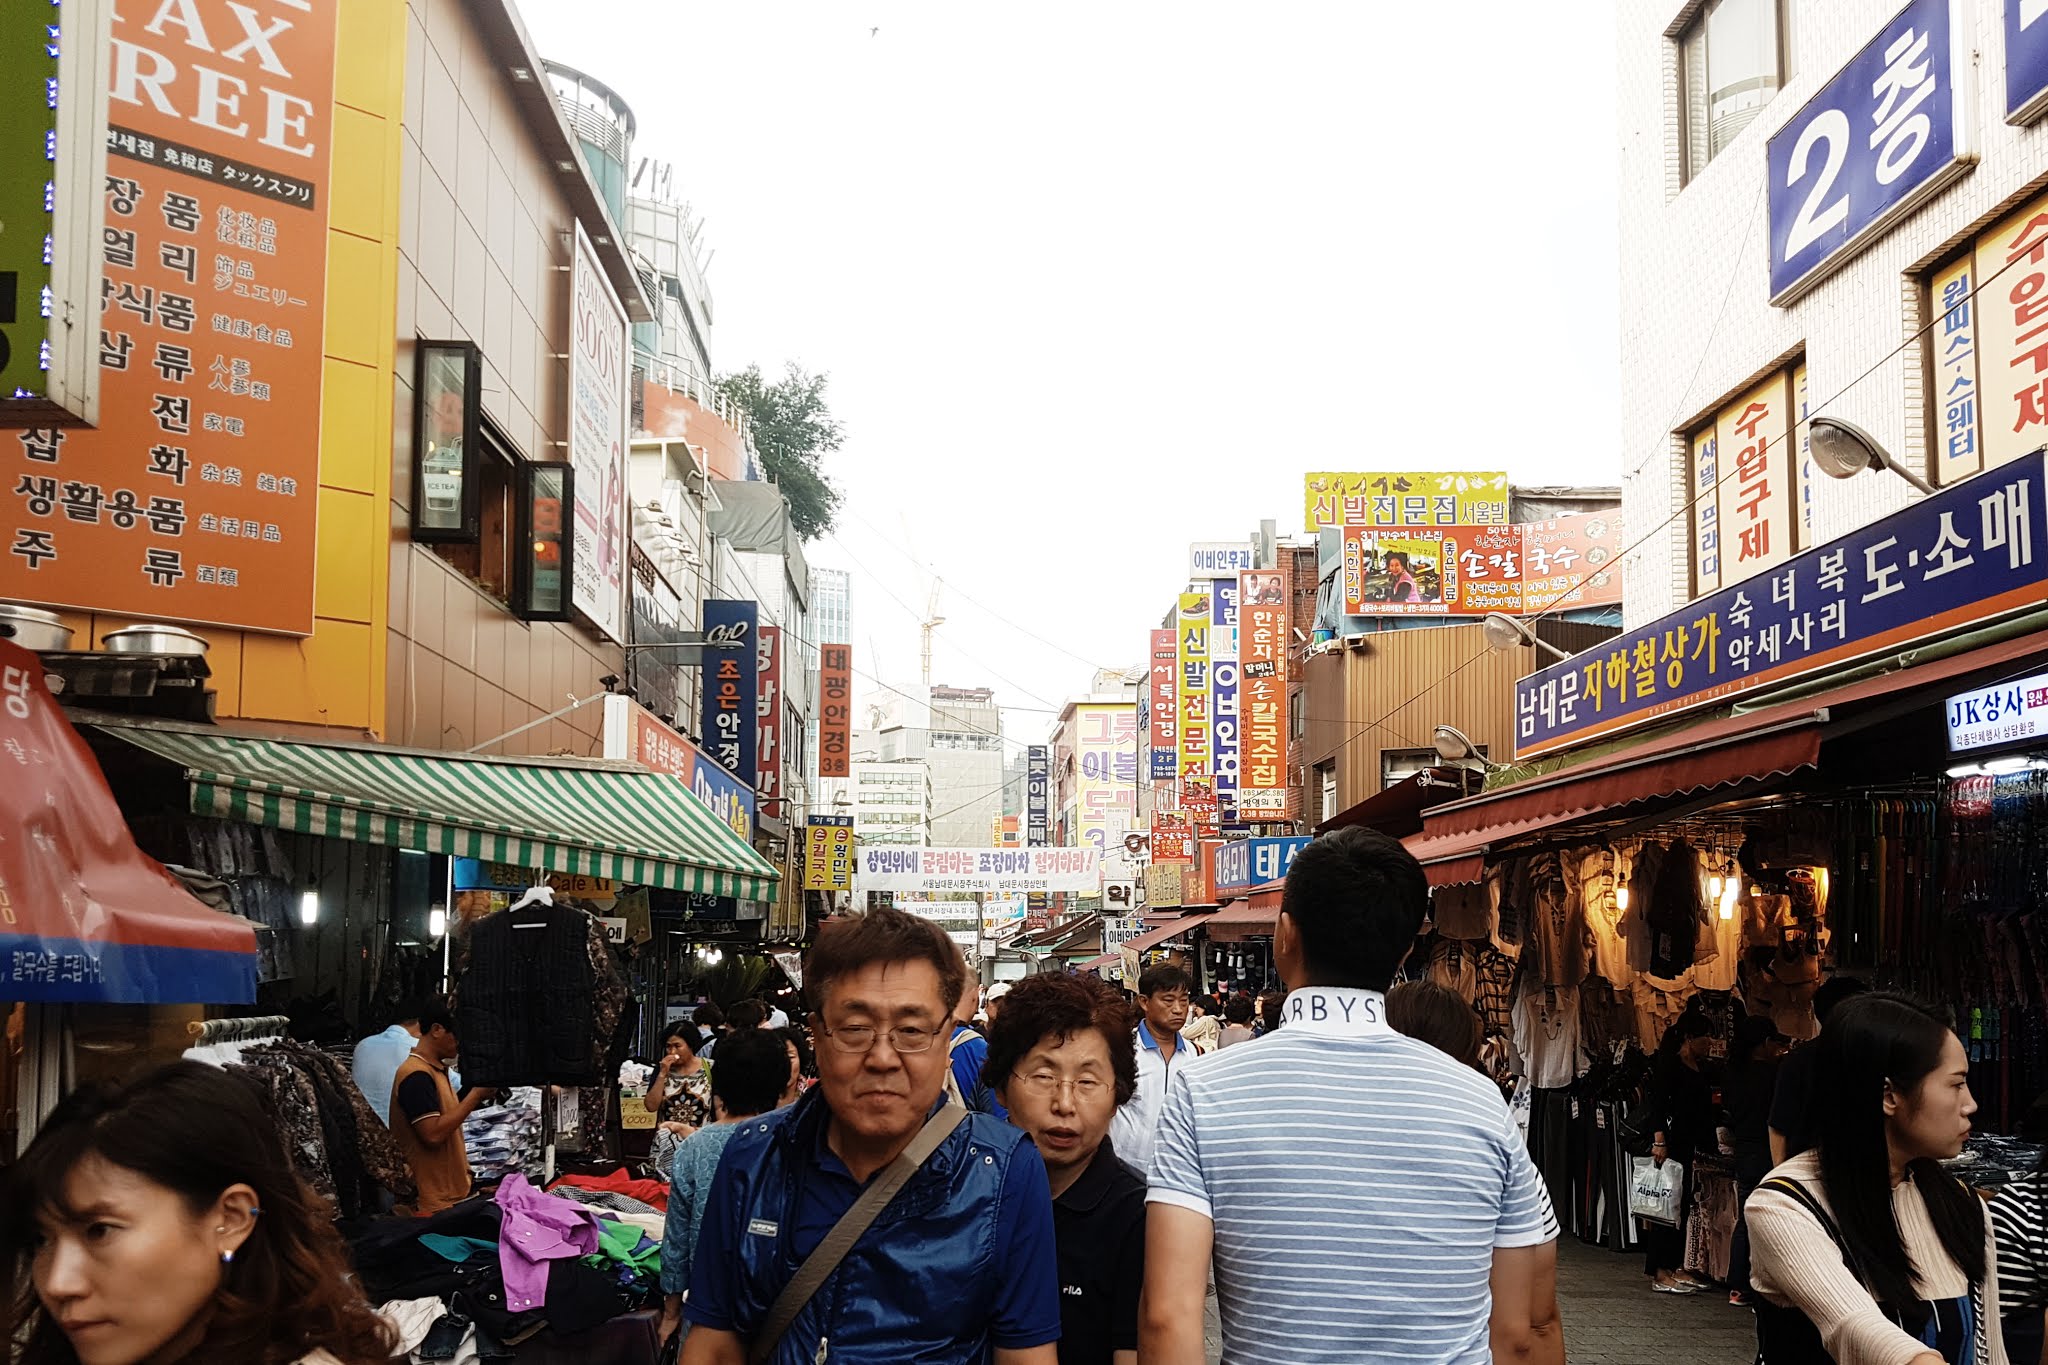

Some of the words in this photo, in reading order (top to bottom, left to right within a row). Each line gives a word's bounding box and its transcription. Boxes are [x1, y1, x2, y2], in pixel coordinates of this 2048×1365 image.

[1784, 27, 1936, 262] 2층
[576, 290, 617, 396] SOON
[15, 474, 187, 537] 생활용품
[427, 483, 440, 491] ICE
[441, 483, 455, 491] TEA
[1734, 401, 1771, 563] 수입구제
[198, 513, 282, 542] 生活用品
[1311, 494, 1458, 526] 신발전문점
[1194, 550, 1250, 570] 이비인후과
[1347, 542, 1359, 601] 착한가격
[1445, 542, 1456, 600] 좋은재료
[1459, 545, 1581, 579] 손칼국수
[1253, 611, 1272, 660] 한순자
[1728, 599, 1848, 672] 악세사리
[715, 659, 742, 770] 조은안경
[823, 648, 848, 754] 대광안경
[2003, 720, 2036, 738] 상담환영
[822, 757, 847, 773] 3층
[811, 827, 829, 888] 손칼국수
[832, 827, 851, 888] 손왕만두
[866, 850, 919, 874] 상인위에
[922, 850, 975, 875] 군림하는
[978, 850, 1031, 874] 포장마차
[1034, 850, 1094, 874] 철거하라!
[922, 879, 991, 889] 서울남대문시장주식회사
[12, 950, 58, 983] 칼국수를
[1636, 1185, 1661, 1199] Alpha
